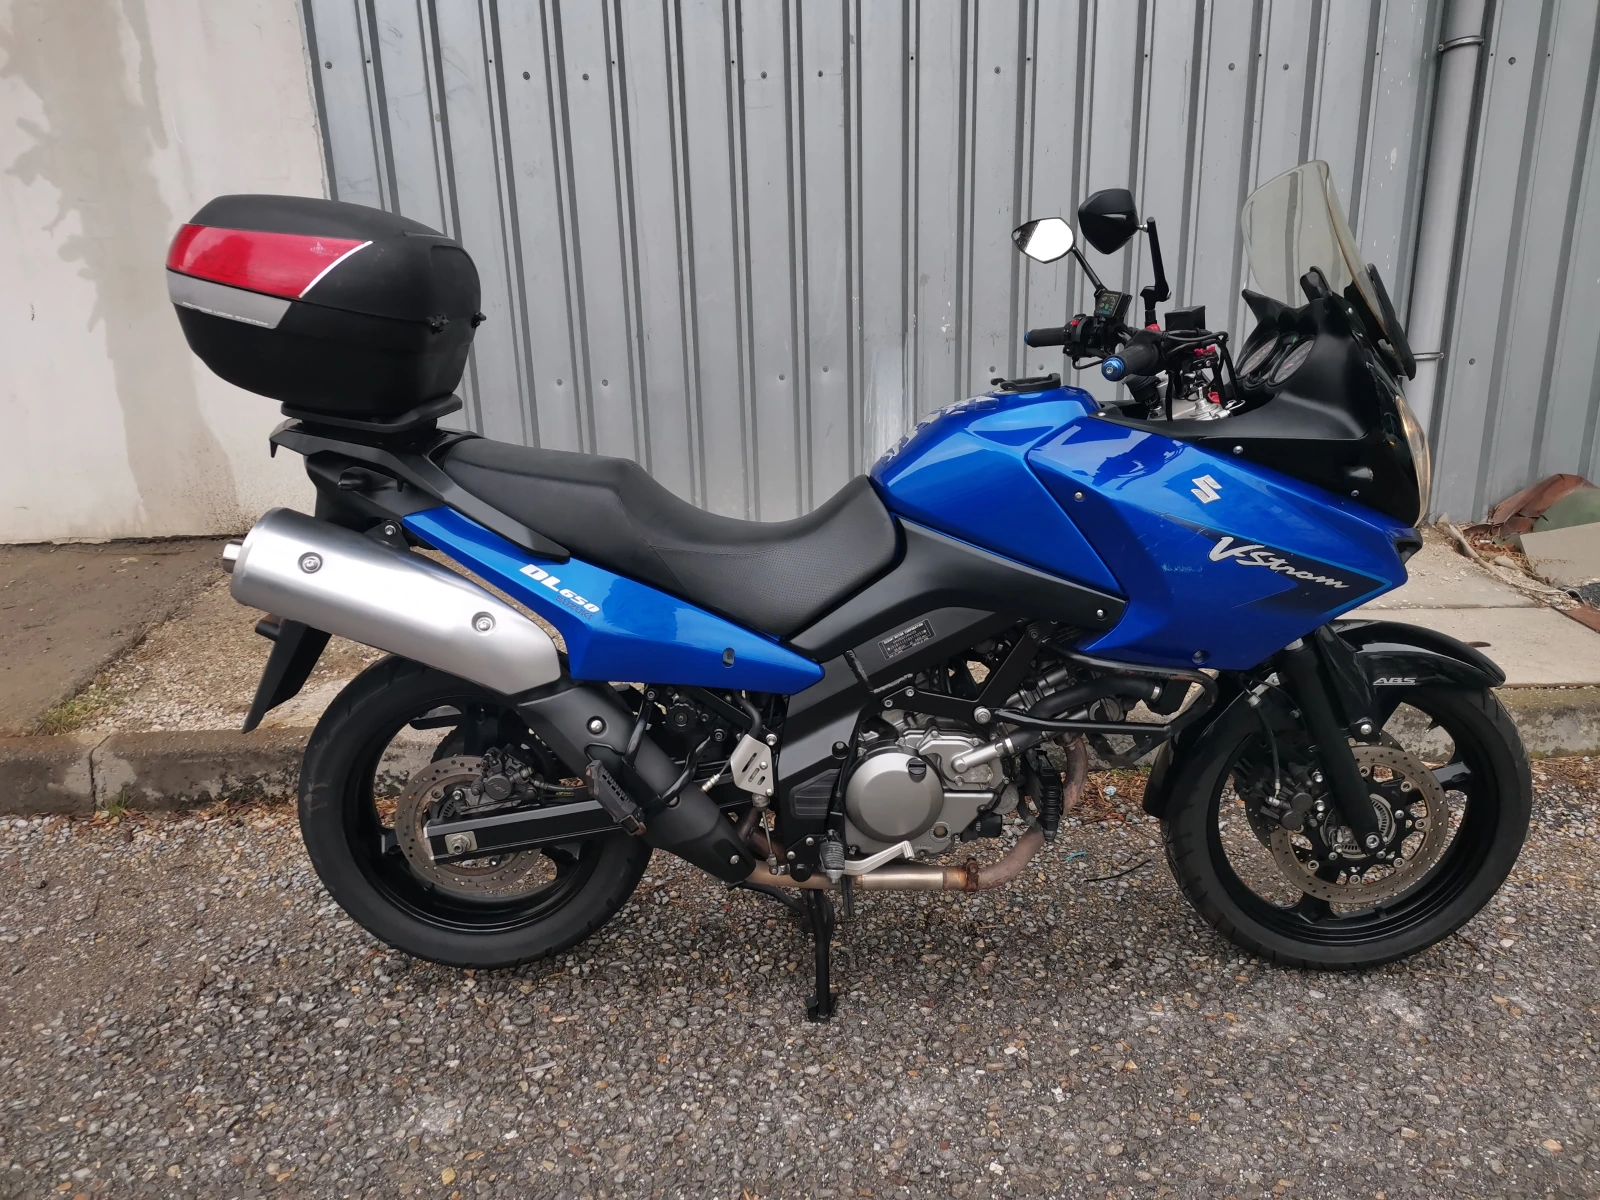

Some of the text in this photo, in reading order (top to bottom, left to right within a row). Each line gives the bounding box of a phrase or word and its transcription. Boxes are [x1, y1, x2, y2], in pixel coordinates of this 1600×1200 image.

[235, 315, 269, 326] SYSTEM
[555, 594, 593, 620] SUZUKI
[1373, 677, 1417, 686] ABS
